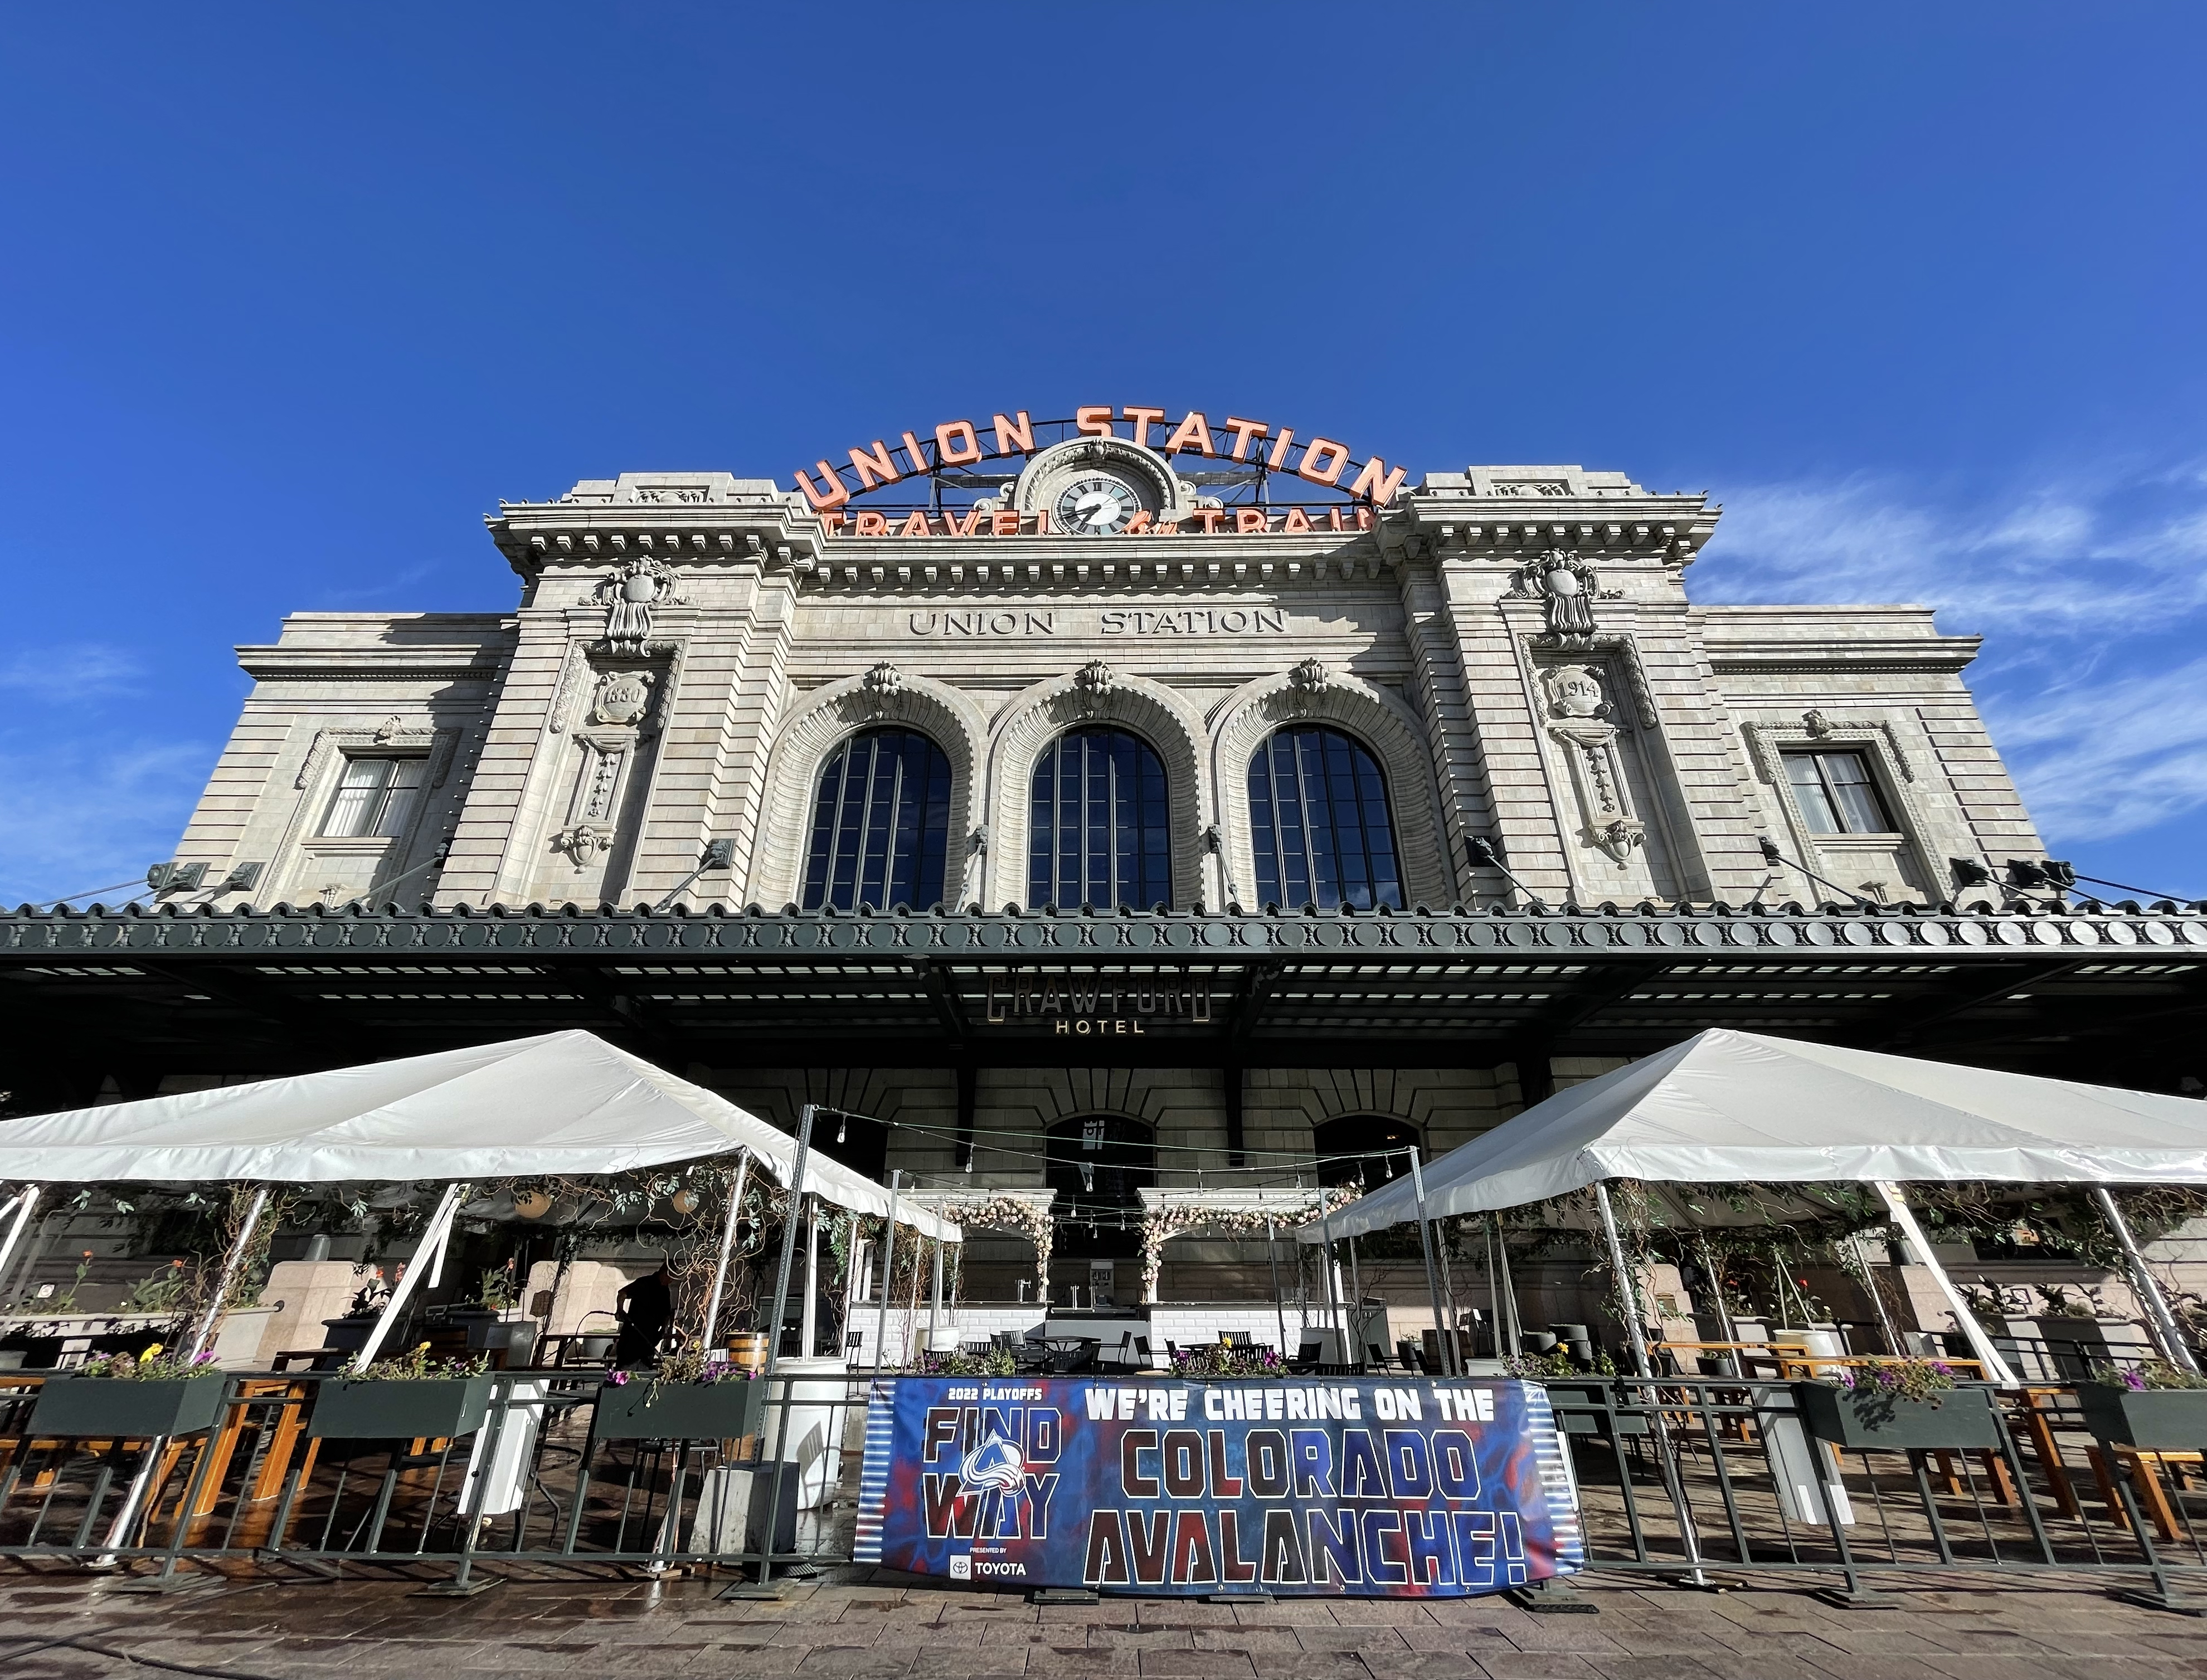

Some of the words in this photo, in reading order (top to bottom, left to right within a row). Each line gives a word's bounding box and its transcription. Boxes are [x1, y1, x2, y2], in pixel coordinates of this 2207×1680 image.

[794, 410, 1036, 511] UNION
[1076, 406, 1408, 507] STATION
[909, 612, 1054, 636] UNION
[1100, 607, 1285, 635] STATION
[1557, 680, 1599, 698] 1914
[985, 971, 1211, 1022] CRAWFORD
[1055, 1019, 1145, 1035] HOTEL
[947, 1388, 978, 1400] 2022
[983, 1388, 1042, 1400] PLAYOFFS
[1085, 1388, 1188, 1421] WE'RE
[1204, 1388, 1360, 1421] CHEERING
[1375, 1387, 1423, 1421] ON
[1435, 1388, 1494, 1421] THE
[923, 1407, 1062, 1463] FIND
[1121, 1428, 1481, 1501] COLORADO
[922, 1473, 1061, 1539] WAY
[1083, 1509, 1527, 1586] AVALANCHE!
[975, 1562, 1026, 1576] TOYOTA
